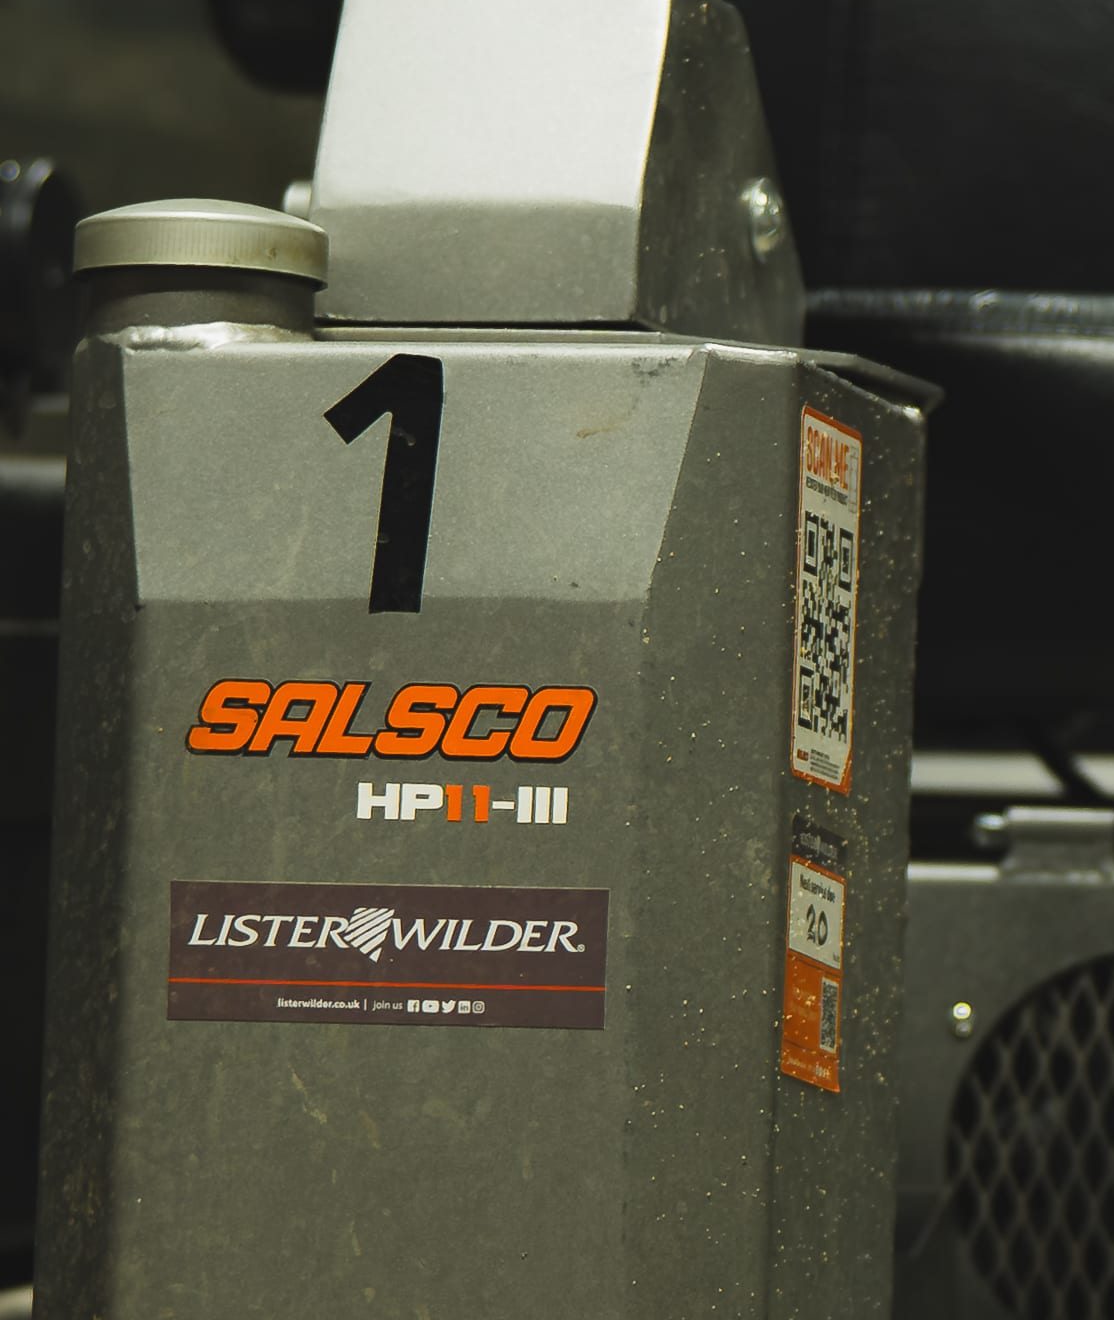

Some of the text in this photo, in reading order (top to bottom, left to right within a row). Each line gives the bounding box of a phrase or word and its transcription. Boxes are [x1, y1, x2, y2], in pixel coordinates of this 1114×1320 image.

[322, 353, 444, 614] 1
[806, 425, 832, 480] SCAN
[833, 438, 850, 491] ME
[185, 679, 598, 762] SALSCO
[357, 781, 569, 825] HP11-III
[187, 913, 350, 948] LISTER
[277, 997, 403, 1011] listerwilder.co.uk join us
